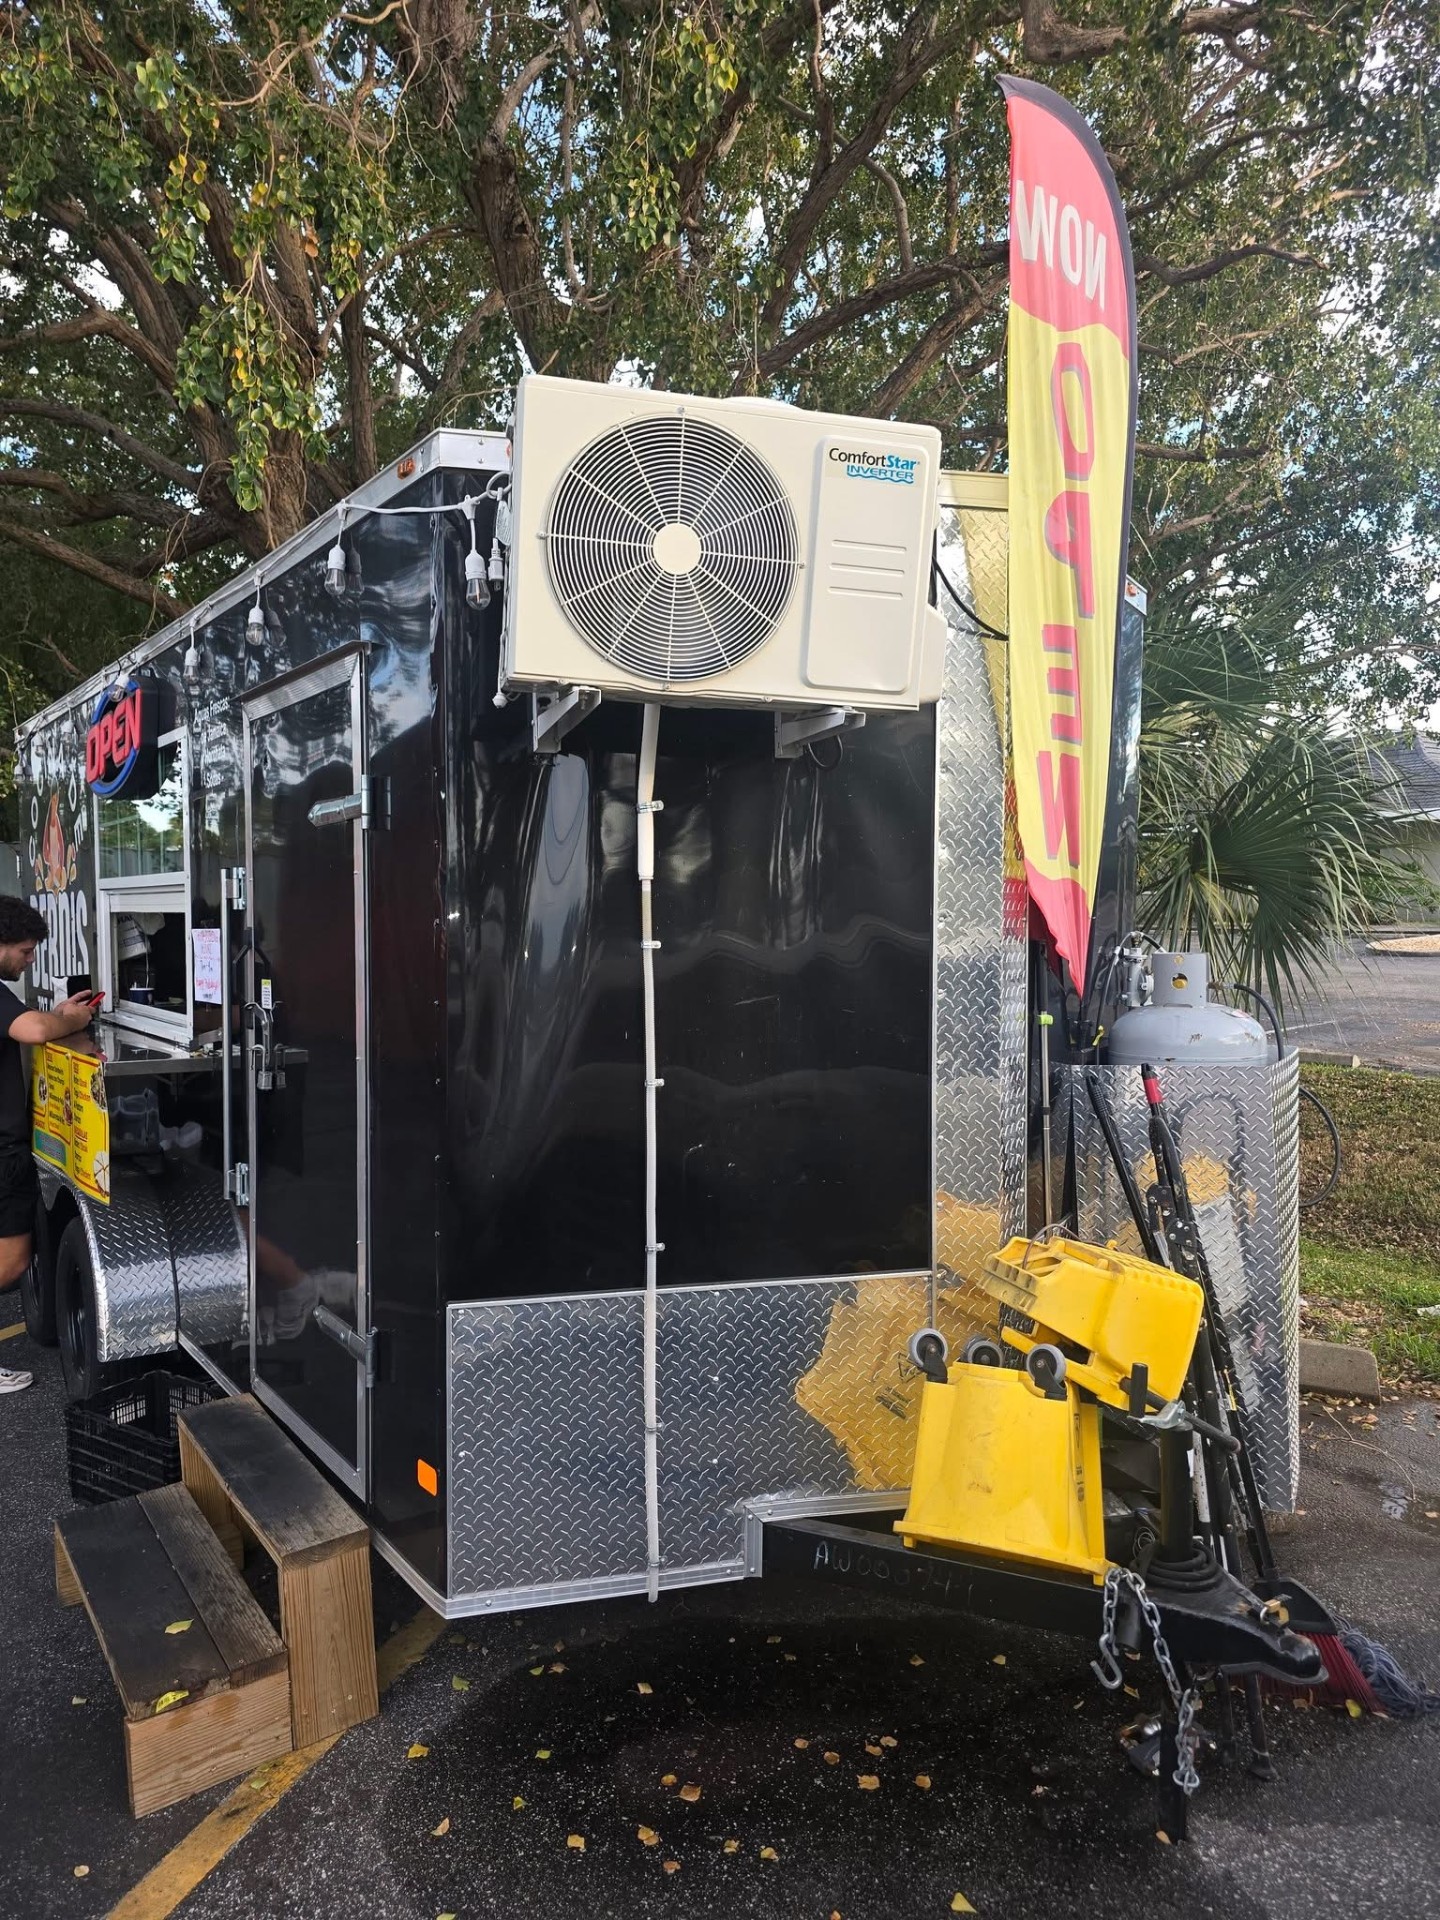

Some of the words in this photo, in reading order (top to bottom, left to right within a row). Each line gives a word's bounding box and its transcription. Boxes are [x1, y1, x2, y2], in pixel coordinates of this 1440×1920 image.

[829, 448, 918, 471] ComfortStar
[847, 465, 914, 481] INVERTER
[86, 688, 142, 784] OPEN
